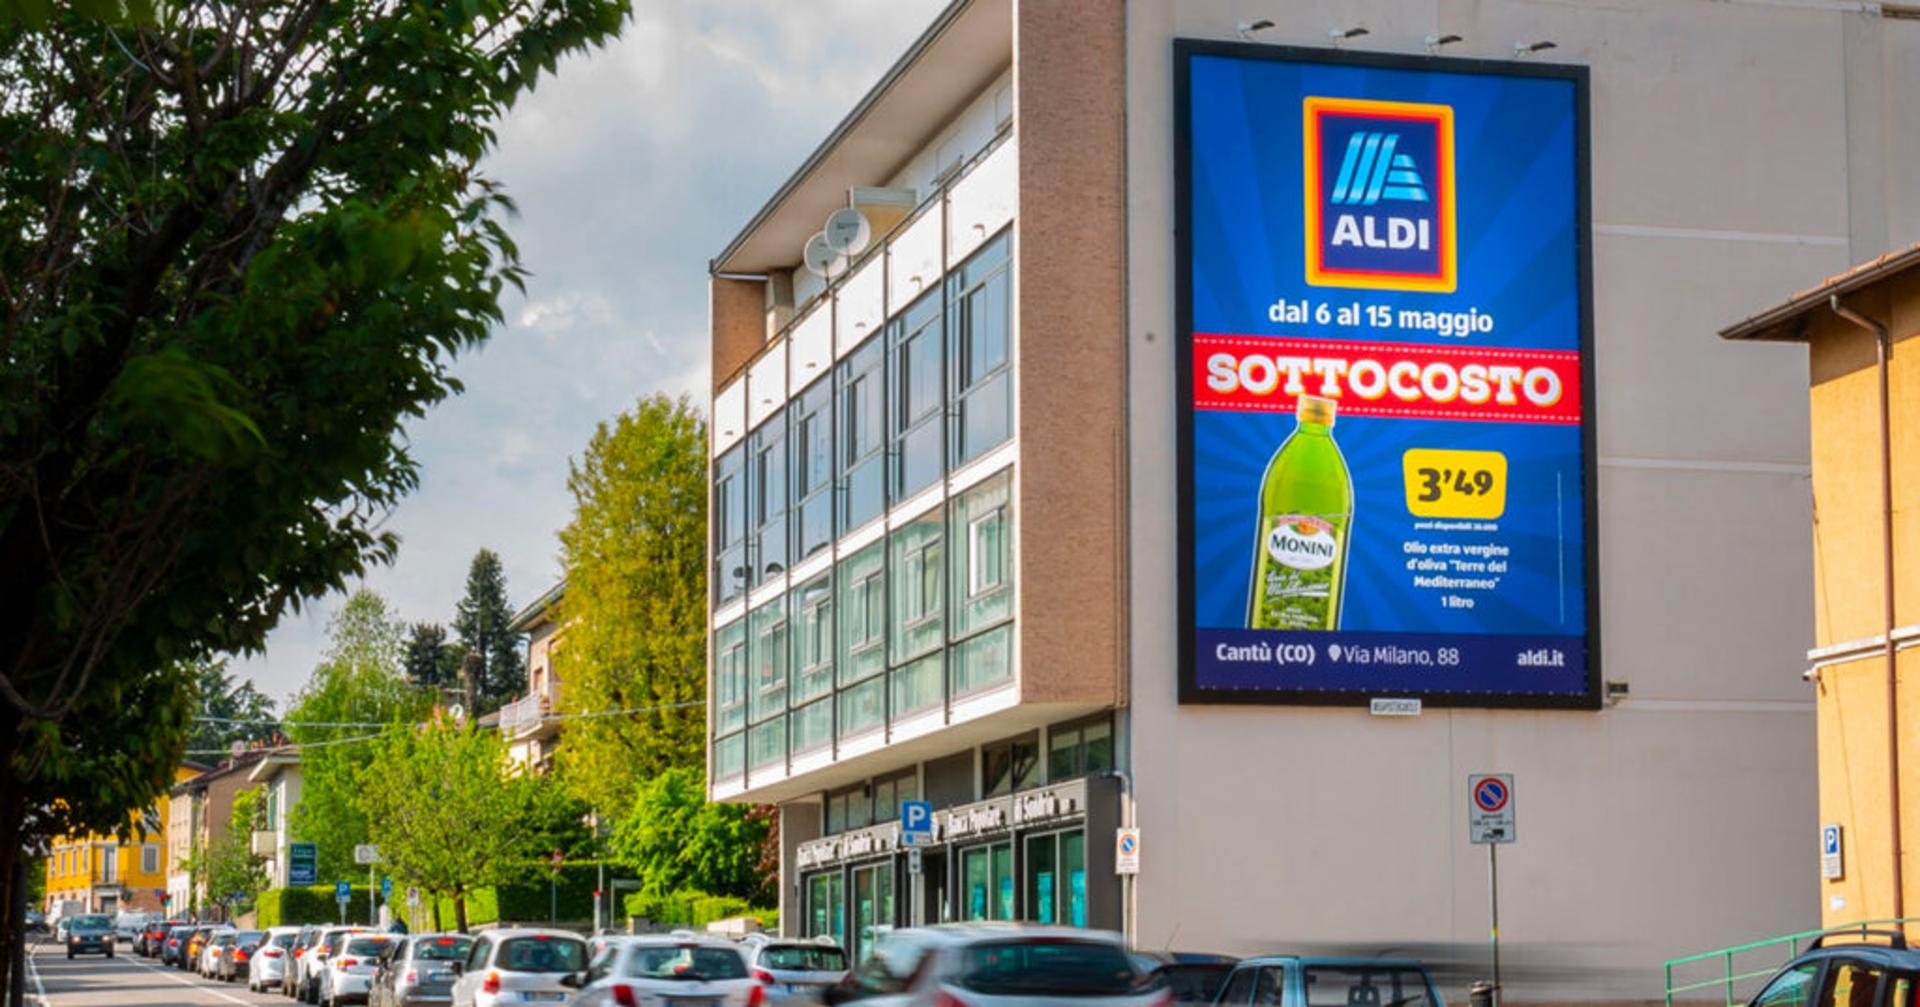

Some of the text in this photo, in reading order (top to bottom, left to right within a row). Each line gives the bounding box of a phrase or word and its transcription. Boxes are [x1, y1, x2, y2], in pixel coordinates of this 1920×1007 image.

[1331, 214, 1430, 250] ALDI
[1268, 299, 1494, 337] dal 6 al 15 maggio
[1206, 352, 1563, 407] SOTTOCOSTO
[1271, 534, 1334, 558] MONINI
[1403, 540, 1510, 558] Olio extra vergine
[1406, 558, 1448, 571] d'oliva
[1487, 560, 1508, 573] del
[1441, 595, 1475, 609] 1 litro
[1216, 642, 1565, 667] Cantù (CO) Via Milano, 88 aldi.it
[908, 805, 926, 828] P
